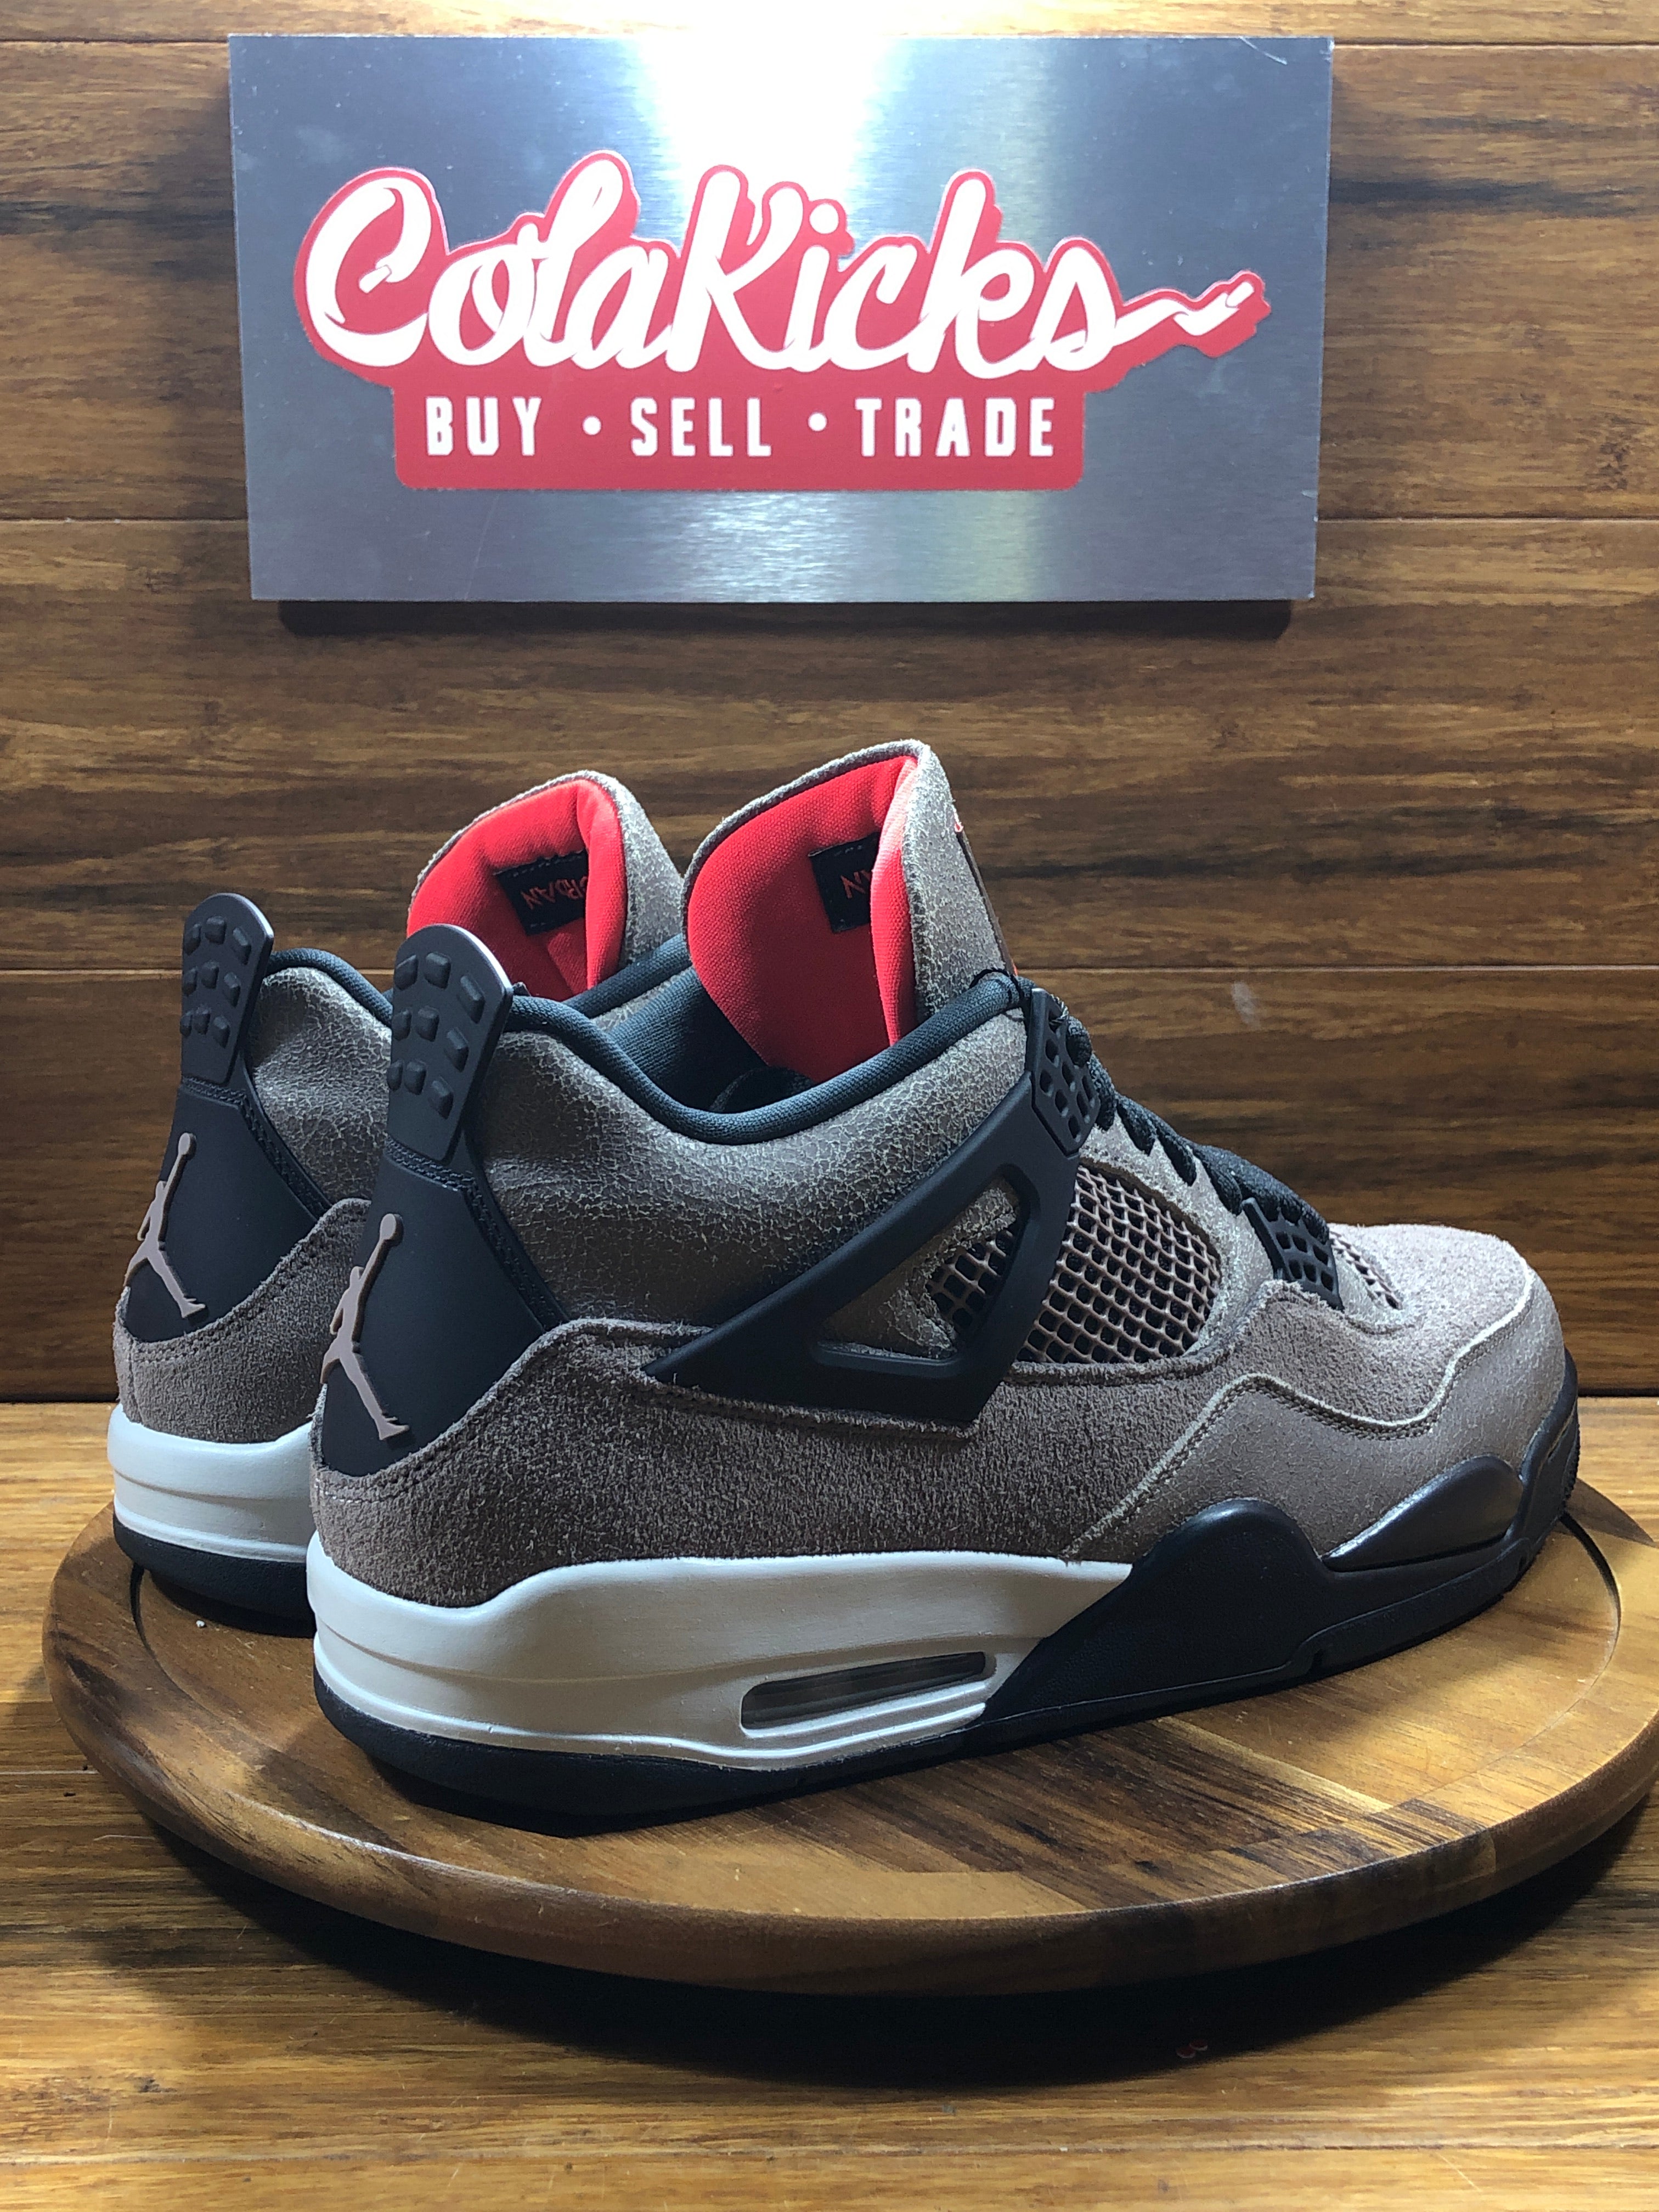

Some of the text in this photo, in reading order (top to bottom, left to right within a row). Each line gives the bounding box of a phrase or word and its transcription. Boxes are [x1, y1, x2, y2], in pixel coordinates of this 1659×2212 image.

[306, 158, 1255, 380] ColaKicks
[425, 396, 1055, 458] BUY SELL TRADE
